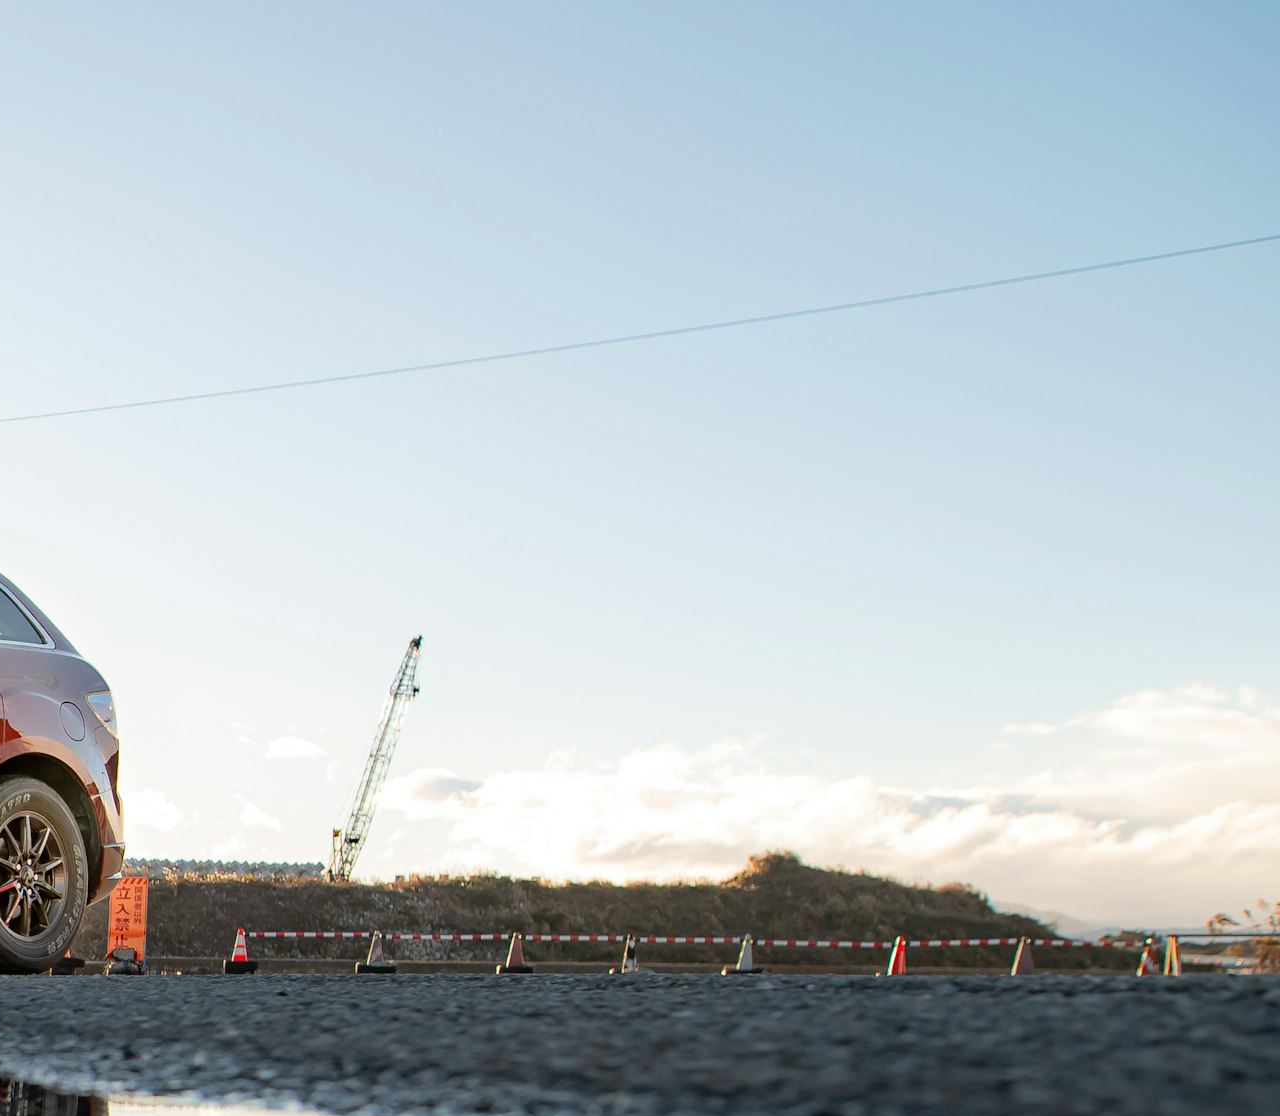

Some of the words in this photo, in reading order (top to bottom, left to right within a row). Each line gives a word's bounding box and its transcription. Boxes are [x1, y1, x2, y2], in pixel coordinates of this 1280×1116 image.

[46, 843, 84, 955] GRANDTREK
[114, 886, 131, 948] 立入禁止
[134, 886, 143, 925] 関係者以外
